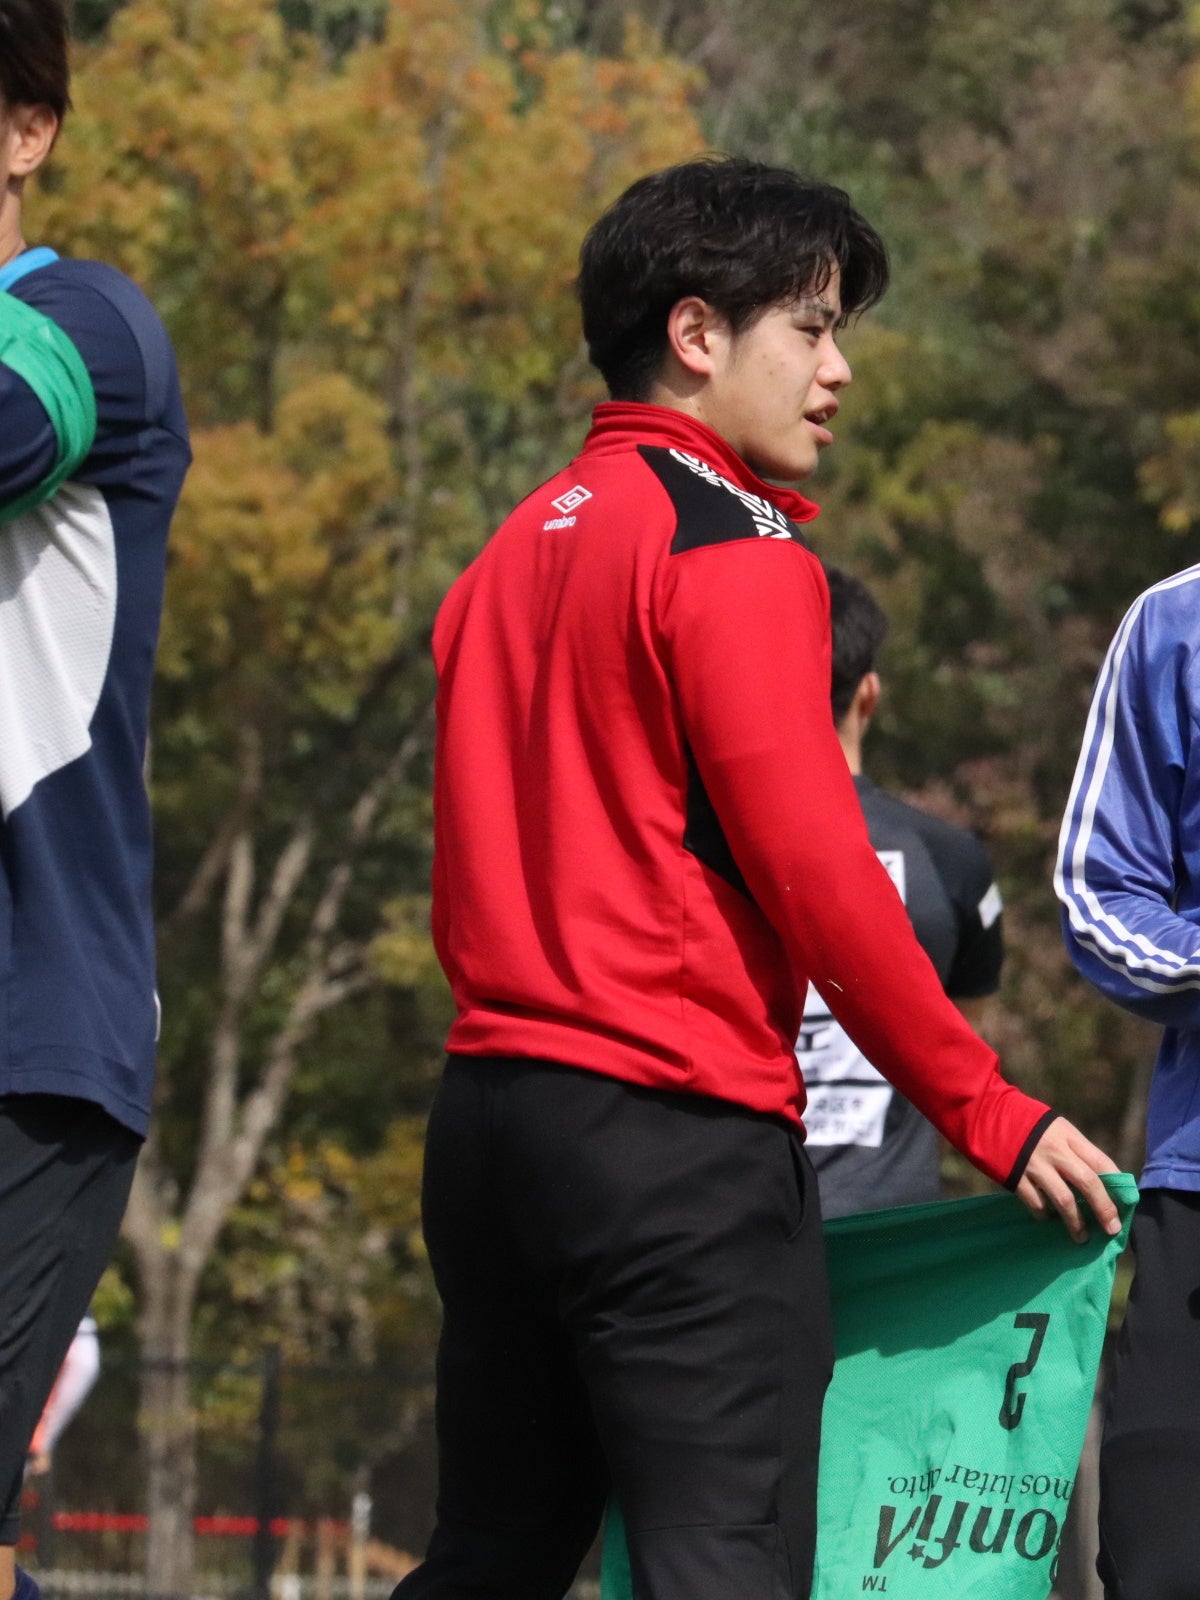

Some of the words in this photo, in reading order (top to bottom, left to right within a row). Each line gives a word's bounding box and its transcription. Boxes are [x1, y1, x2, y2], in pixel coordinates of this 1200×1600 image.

[543, 516, 576, 530] umbro
[999, 1313, 1050, 1431] 2
[945, 1464, 1015, 1503] lutar
[862, 1576, 886, 1592] TM
